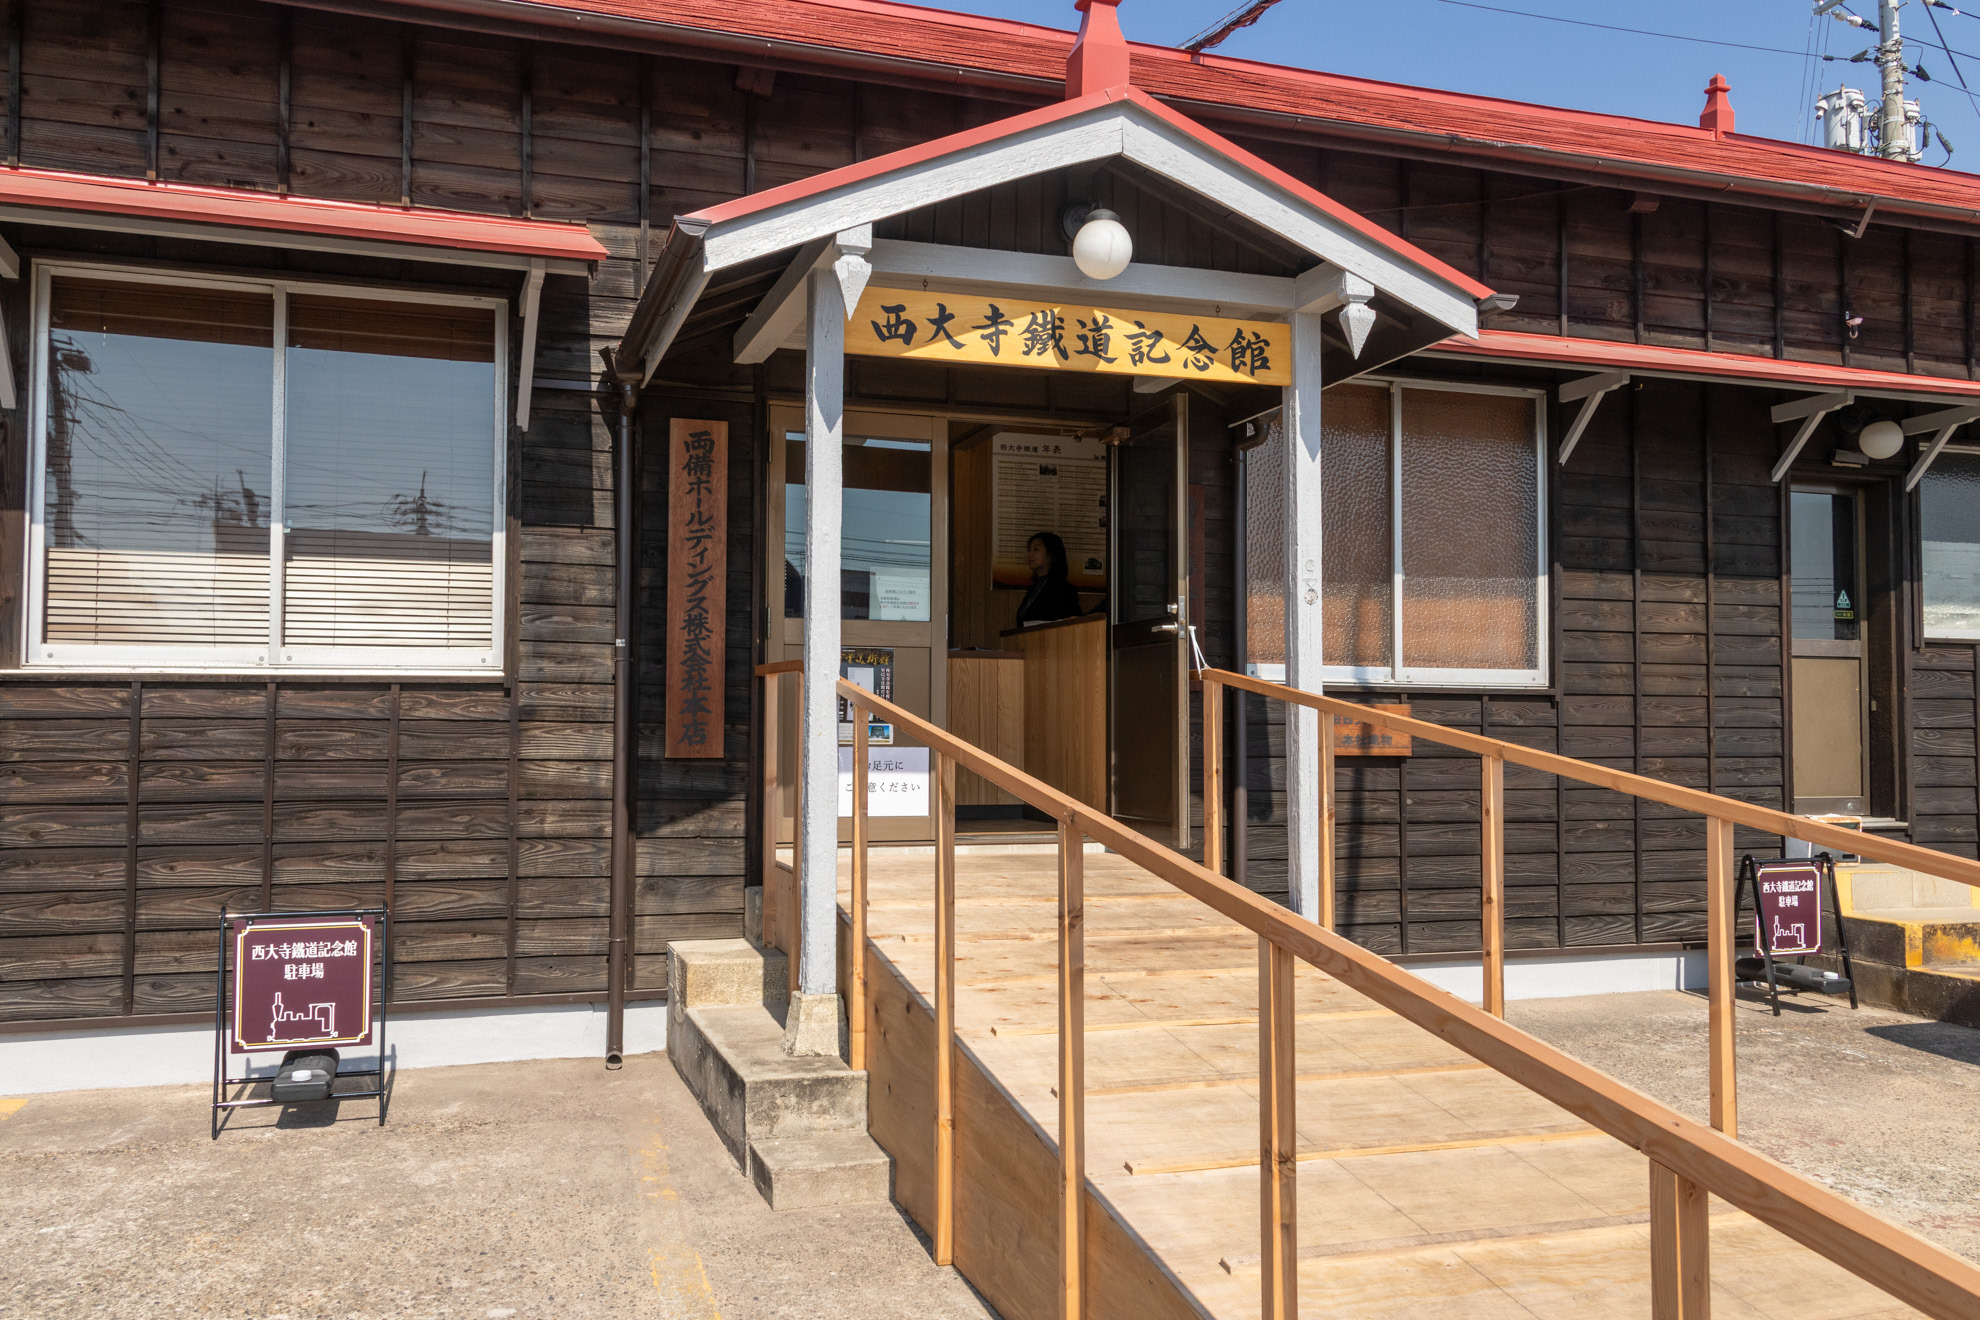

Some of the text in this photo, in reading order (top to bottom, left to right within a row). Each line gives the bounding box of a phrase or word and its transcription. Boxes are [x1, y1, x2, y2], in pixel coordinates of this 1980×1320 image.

[871, 302, 1273, 377] 西大寺鐵道記念館
[1042, 444, 1062, 455] 年表
[679, 430, 715, 746] 両備ホールディングス株式会社本店
[845, 781, 921, 793] ご意ください
[1778, 895, 1799, 908] 駐車場
[251, 940, 358, 960] 西大寺鐵道記念館
[284, 963, 325, 980] 駐車場
